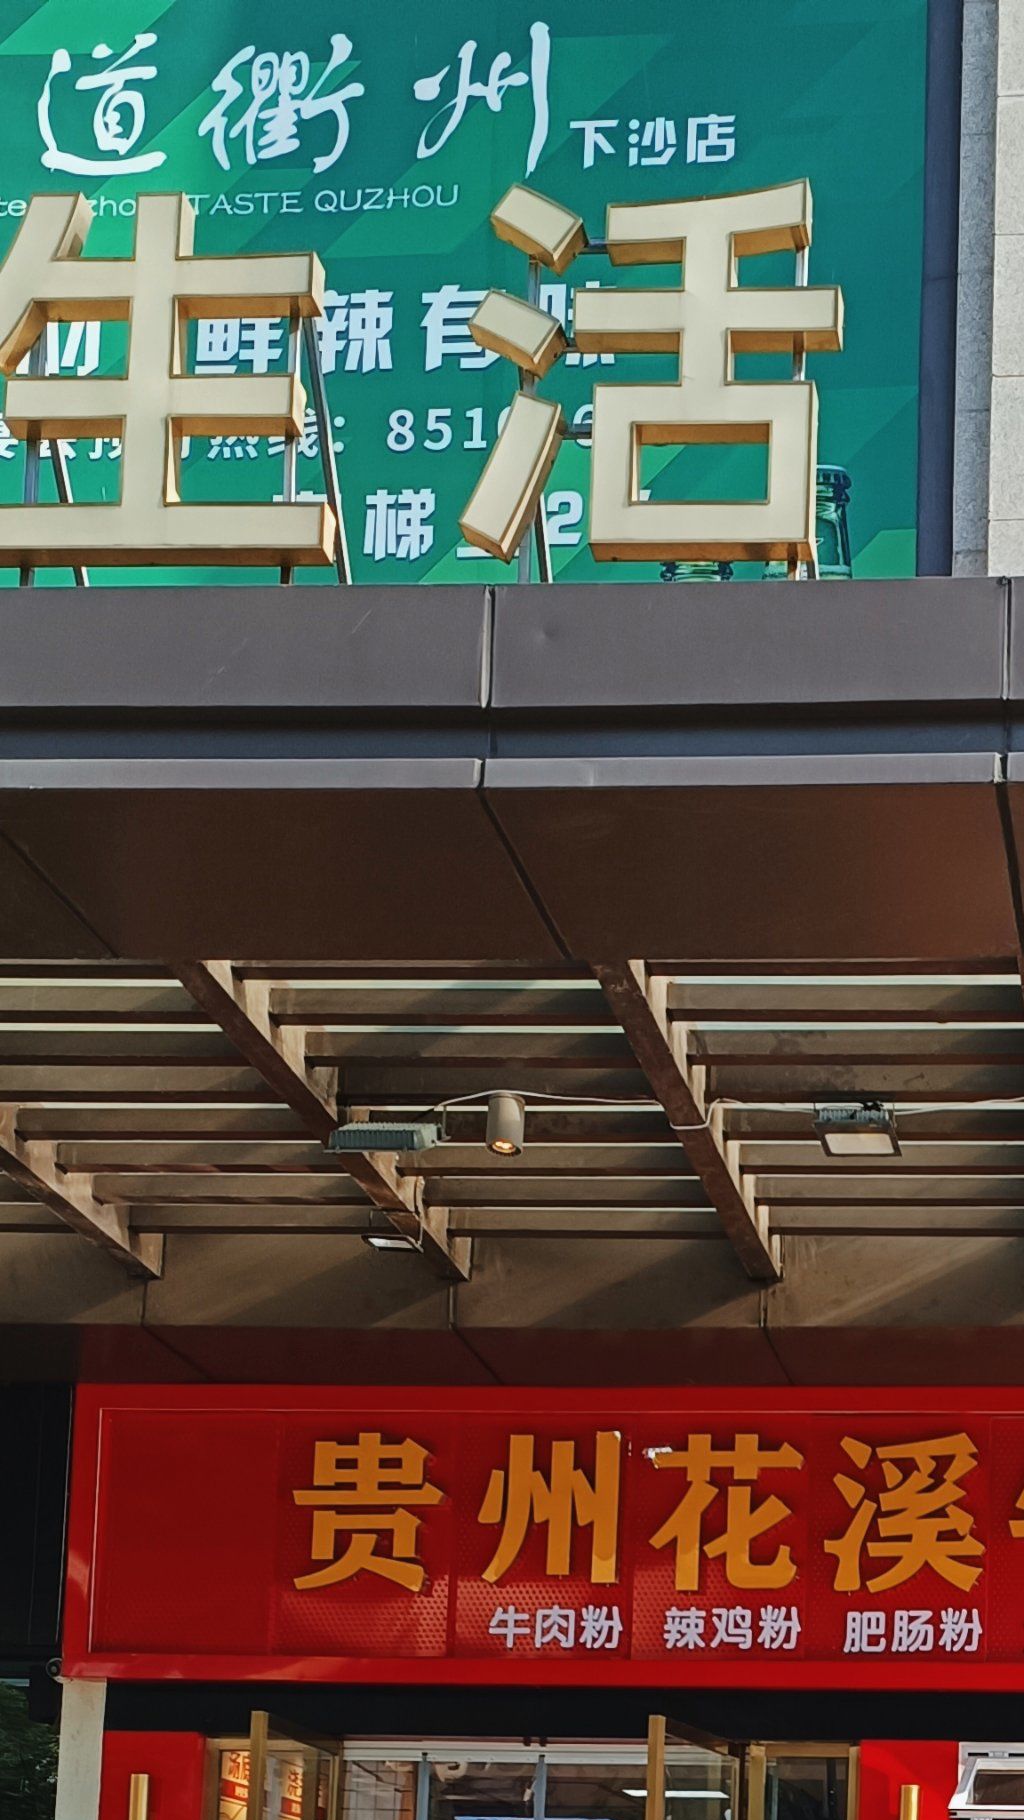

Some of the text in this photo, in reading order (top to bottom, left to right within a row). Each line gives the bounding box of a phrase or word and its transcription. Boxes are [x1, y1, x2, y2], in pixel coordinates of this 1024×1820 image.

[569, 114, 736, 167] 下沙店
[190, 191, 303, 217] TASTE
[314, 184, 459, 213] QUZHOU
[0, 178, 845, 565] 生活
[488, 1605, 624, 1649] 牛肉粉
[663, 1605, 801, 1651] 辣鸡粉
[843, 1607, 983, 1654] 肥肠粉
